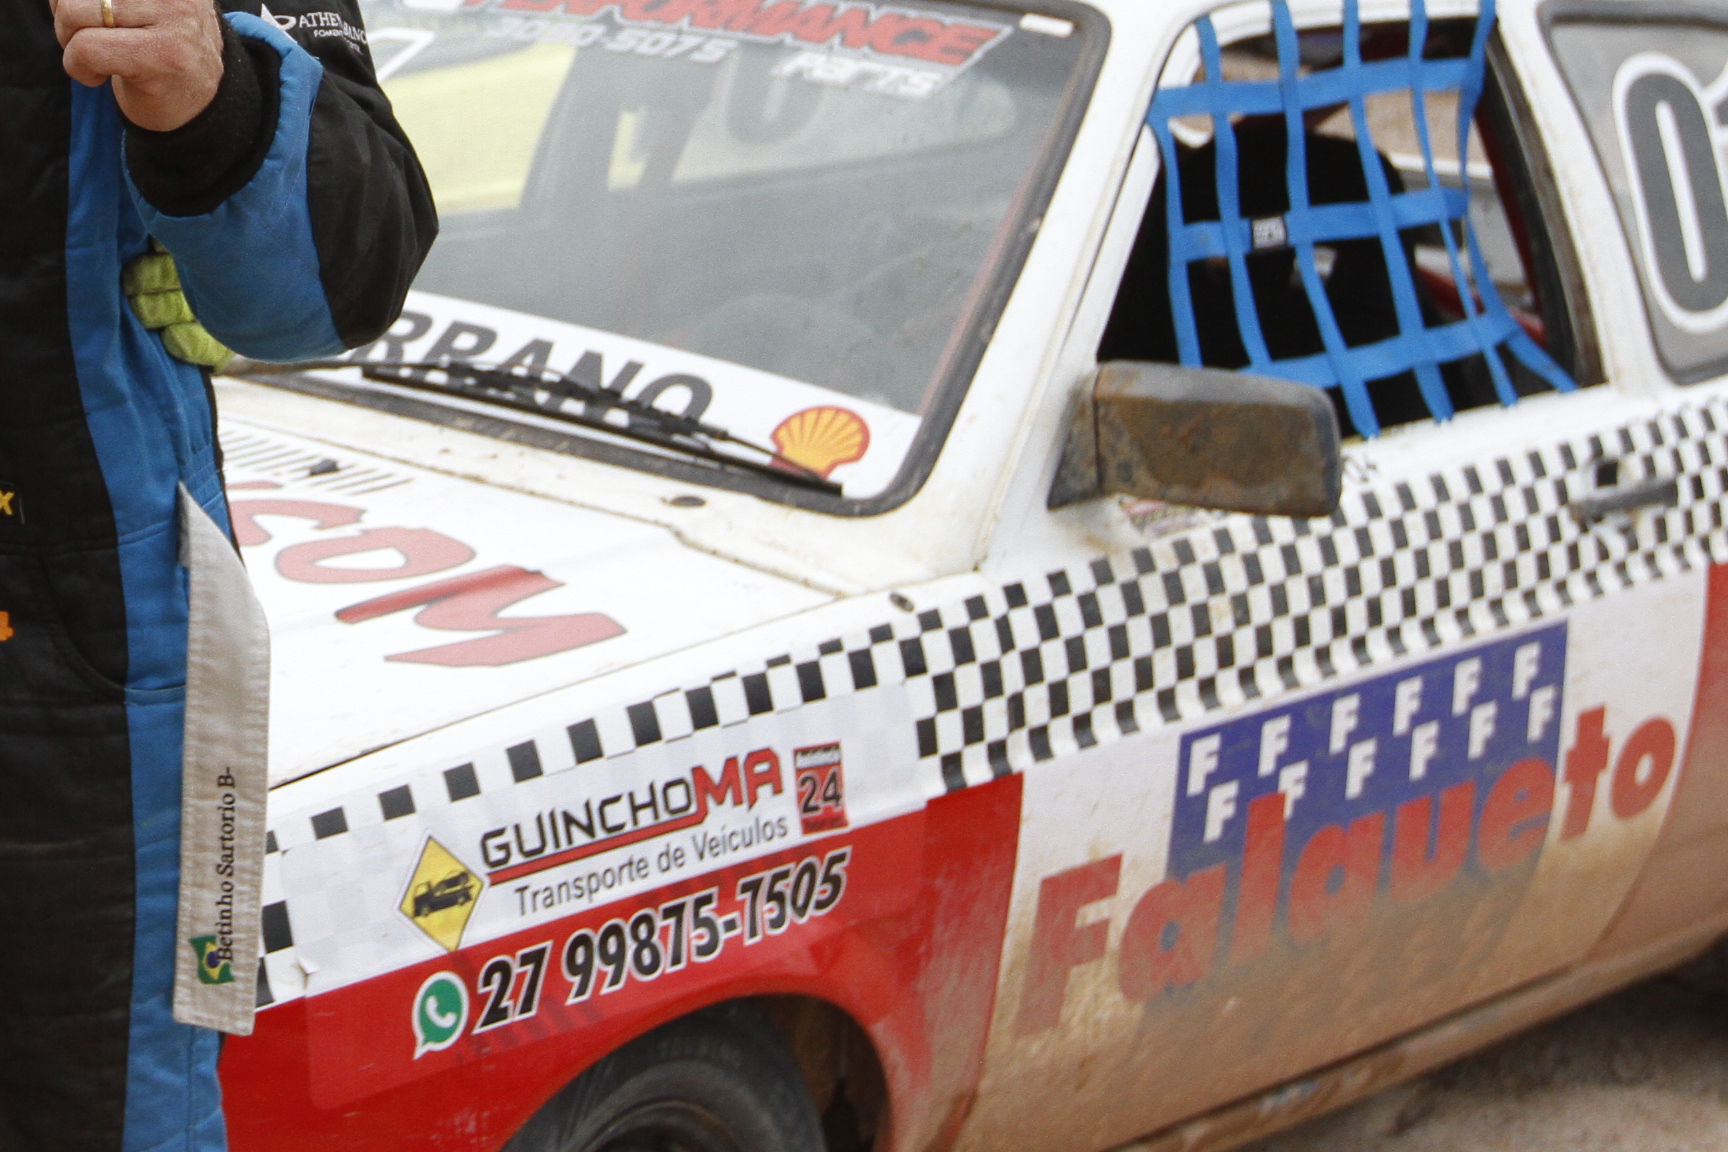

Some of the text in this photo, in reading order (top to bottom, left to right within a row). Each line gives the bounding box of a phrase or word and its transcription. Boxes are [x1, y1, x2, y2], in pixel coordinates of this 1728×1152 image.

[797, 767, 843, 816] 24
[216, 793, 236, 878] Sartorio
[514, 849, 650, 916] Transporte
[657, 842, 686, 874] de
[689, 812, 789, 863] Veículos
[216, 881, 234, 963] Betinho
[472, 846, 853, 1035] 27 99875-7505
